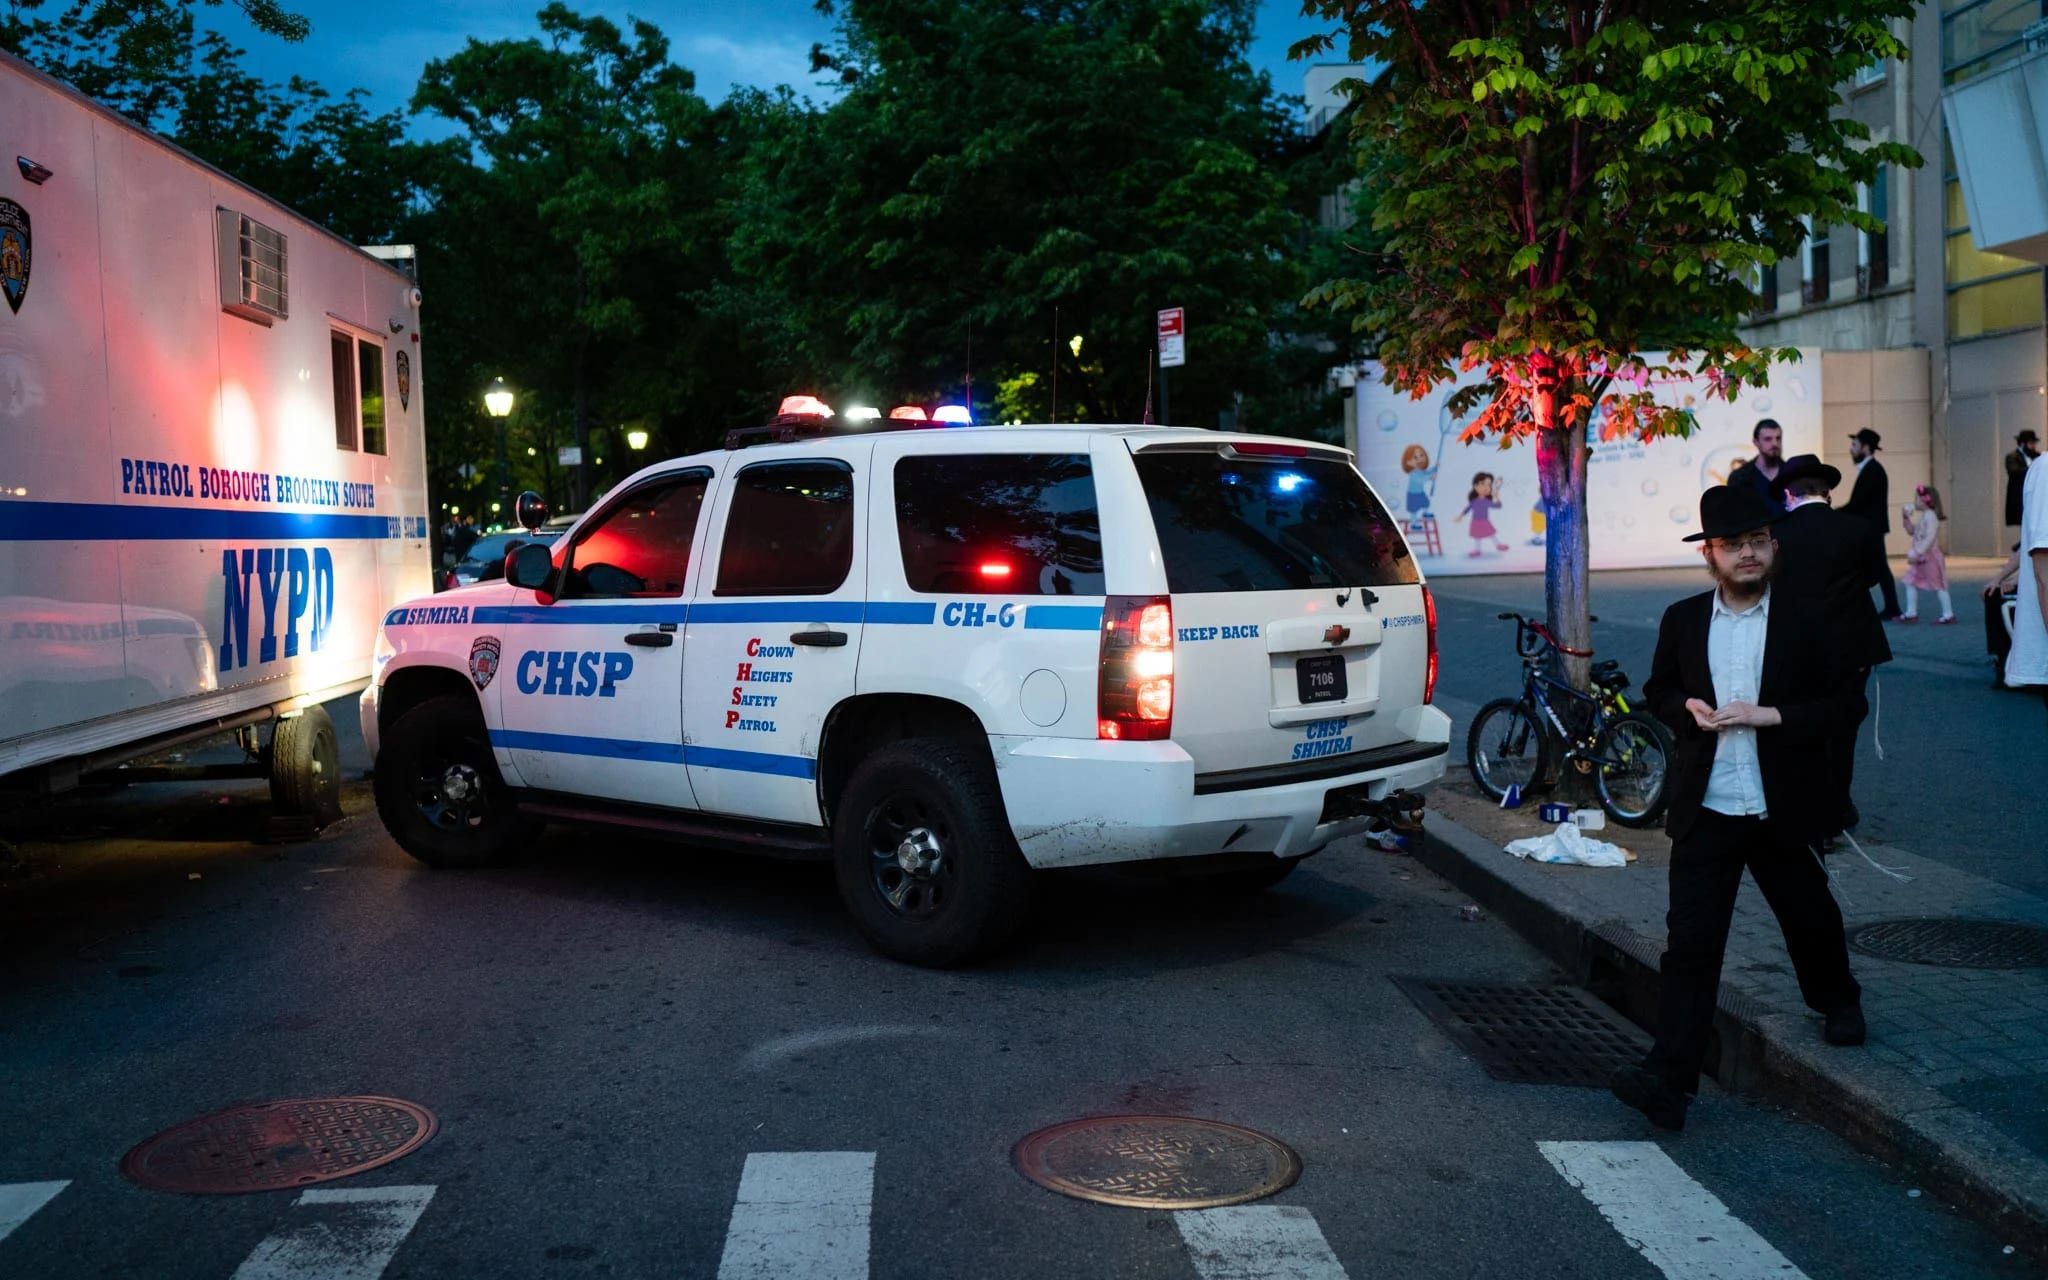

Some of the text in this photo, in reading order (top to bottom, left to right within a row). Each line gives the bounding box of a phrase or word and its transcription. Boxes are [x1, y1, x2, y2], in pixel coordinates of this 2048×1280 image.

[121, 458, 375, 508] PATROL BOROUGH BROOKLYN SOUTH
[219, 547, 334, 672] NYPD
[407, 606, 469, 625] SHMIRA
[942, 602, 1015, 627] CH-6
[1178, 624, 1260, 642] KEEP BACK
[746, 638, 795, 658] CROWN
[516, 650, 634, 698] CHSP
[736, 663, 793, 684] HEIGHTS
[1310, 671, 1334, 687] 7106
[731, 687, 778, 708] SAFETY
[725, 710, 777, 733] PATROL
[1306, 720, 1348, 740] CHSP
[1291, 736, 1353, 761] SHMIRA
